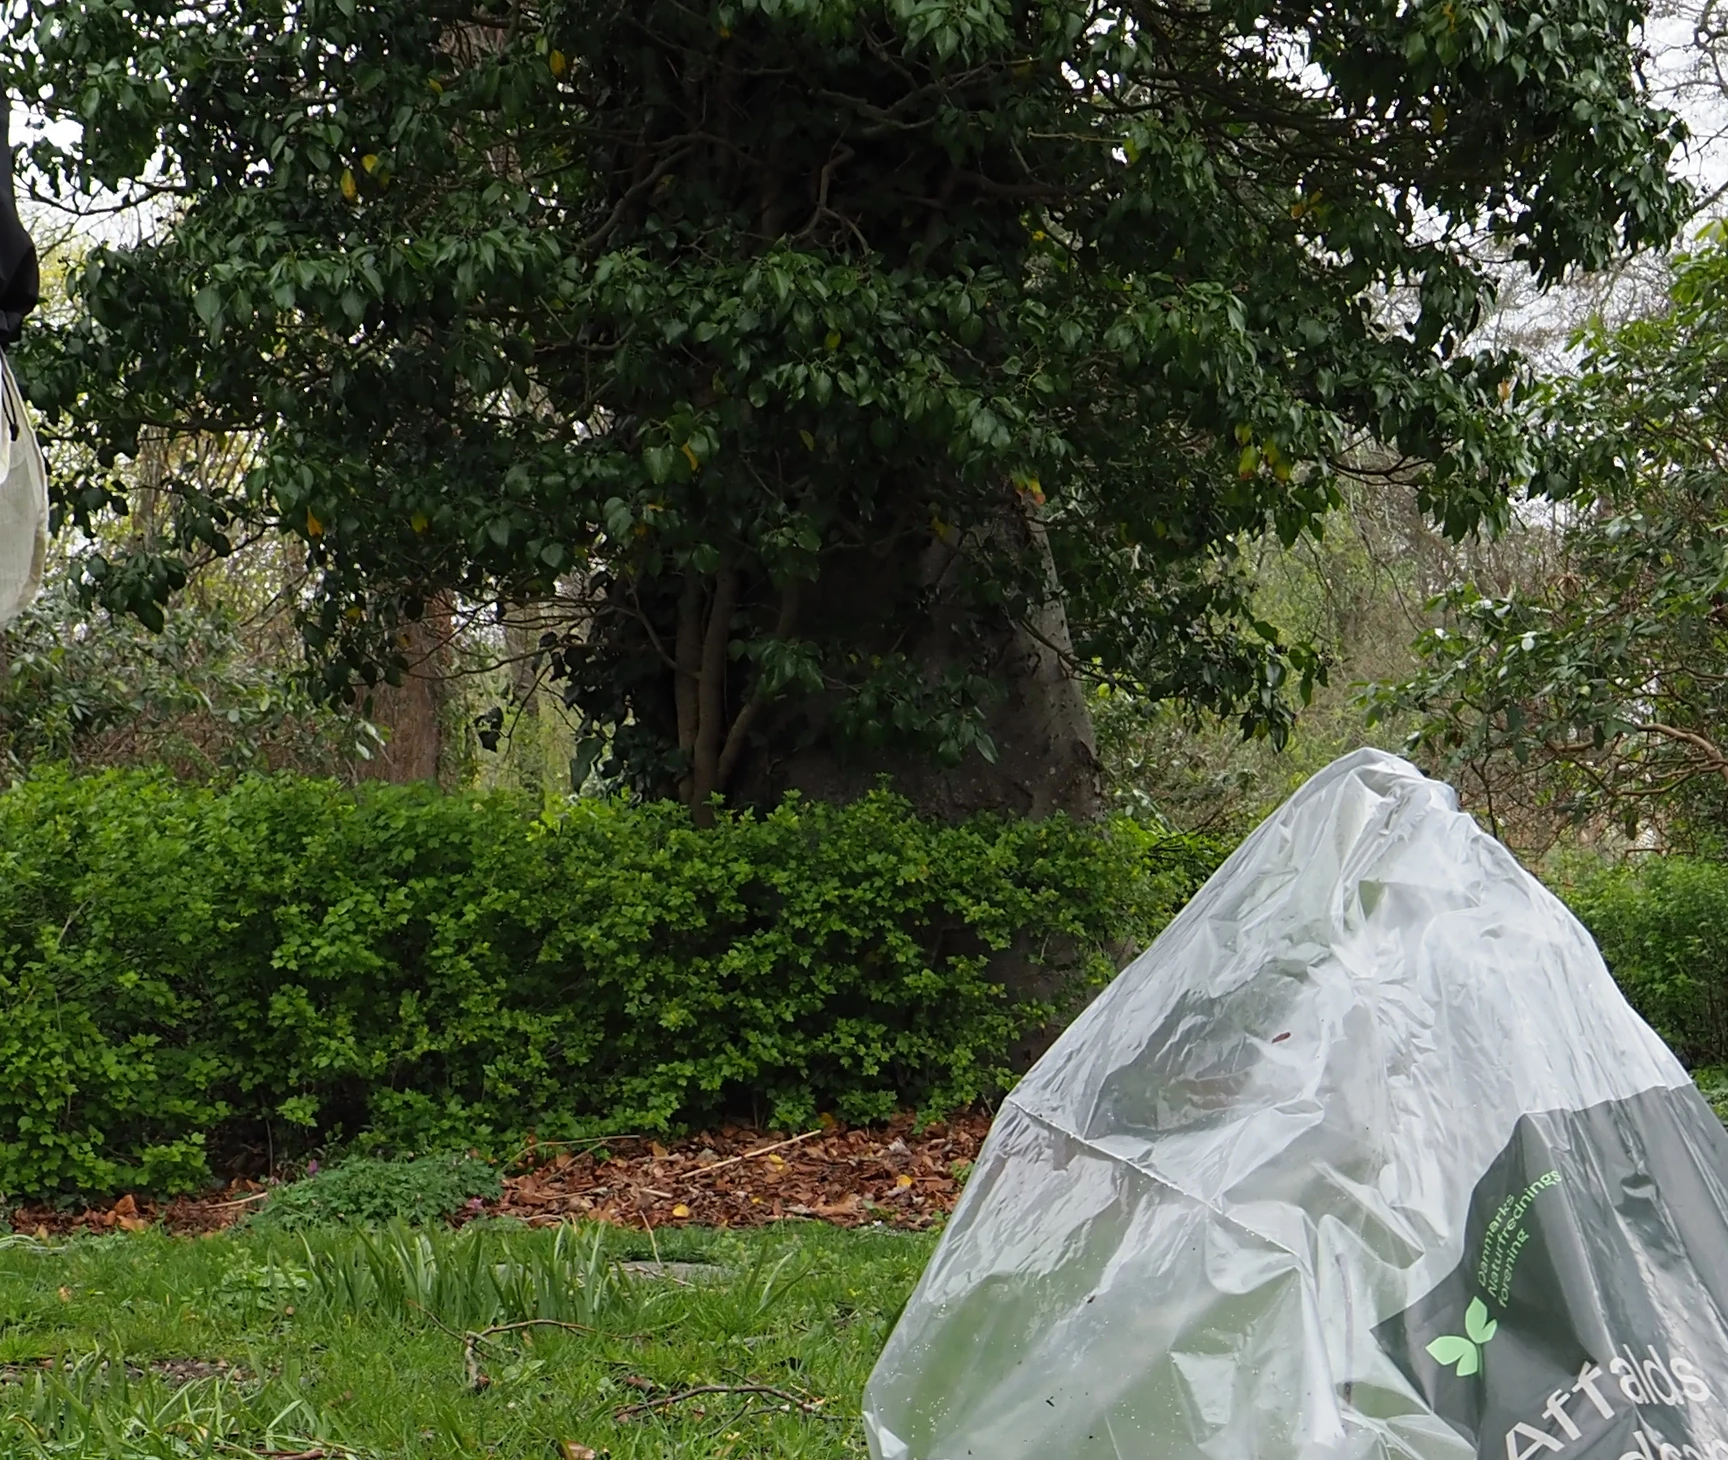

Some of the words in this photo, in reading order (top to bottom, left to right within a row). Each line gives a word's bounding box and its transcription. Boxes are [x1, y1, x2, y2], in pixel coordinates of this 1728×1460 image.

[1478, 1194, 1514, 1287] Danmarks
[1488, 1170, 1562, 1298] Naturfrednings
[1499, 1228, 1530, 1308] forening
